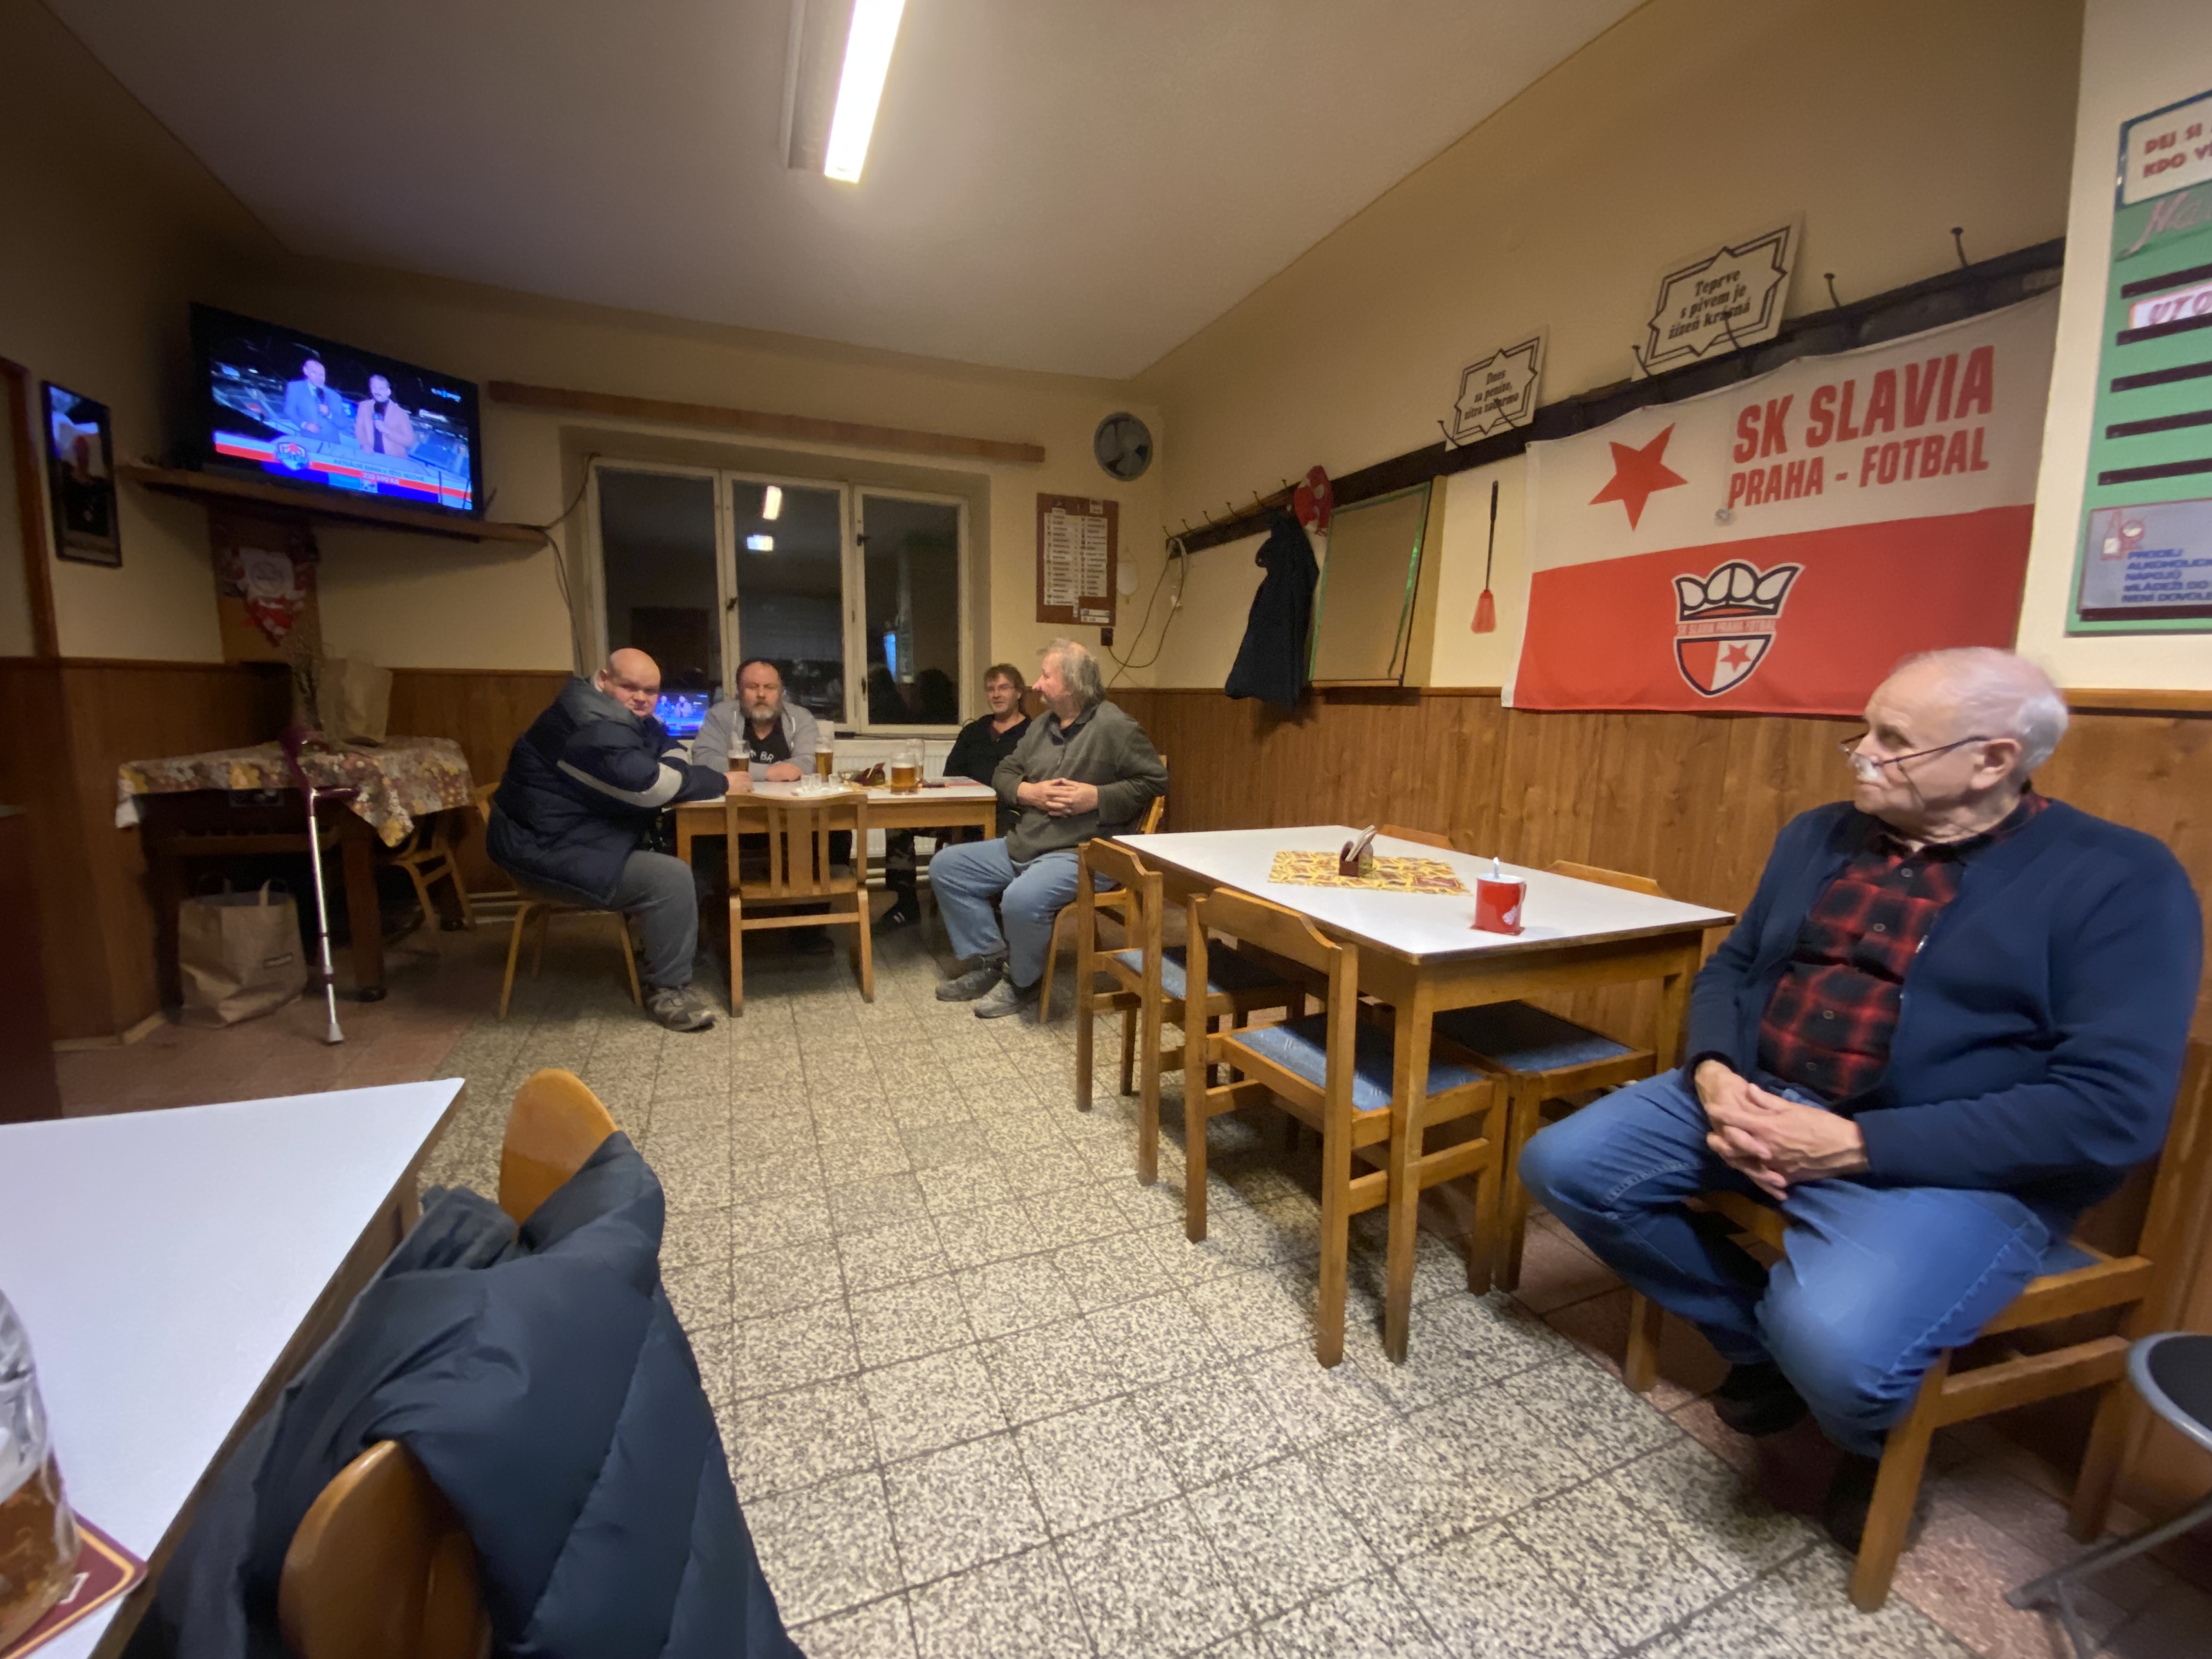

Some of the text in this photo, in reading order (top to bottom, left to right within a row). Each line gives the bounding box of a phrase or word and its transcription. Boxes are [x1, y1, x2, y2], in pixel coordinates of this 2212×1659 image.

[2142, 153, 2187, 178] KDO
[1695, 270, 1740, 297] Teprve
[1680, 284, 1746, 319] s pivem je
[1733, 345, 1994, 464] SK SLAVIA
[1728, 427, 1989, 509] PRAHA - FOTBAL
